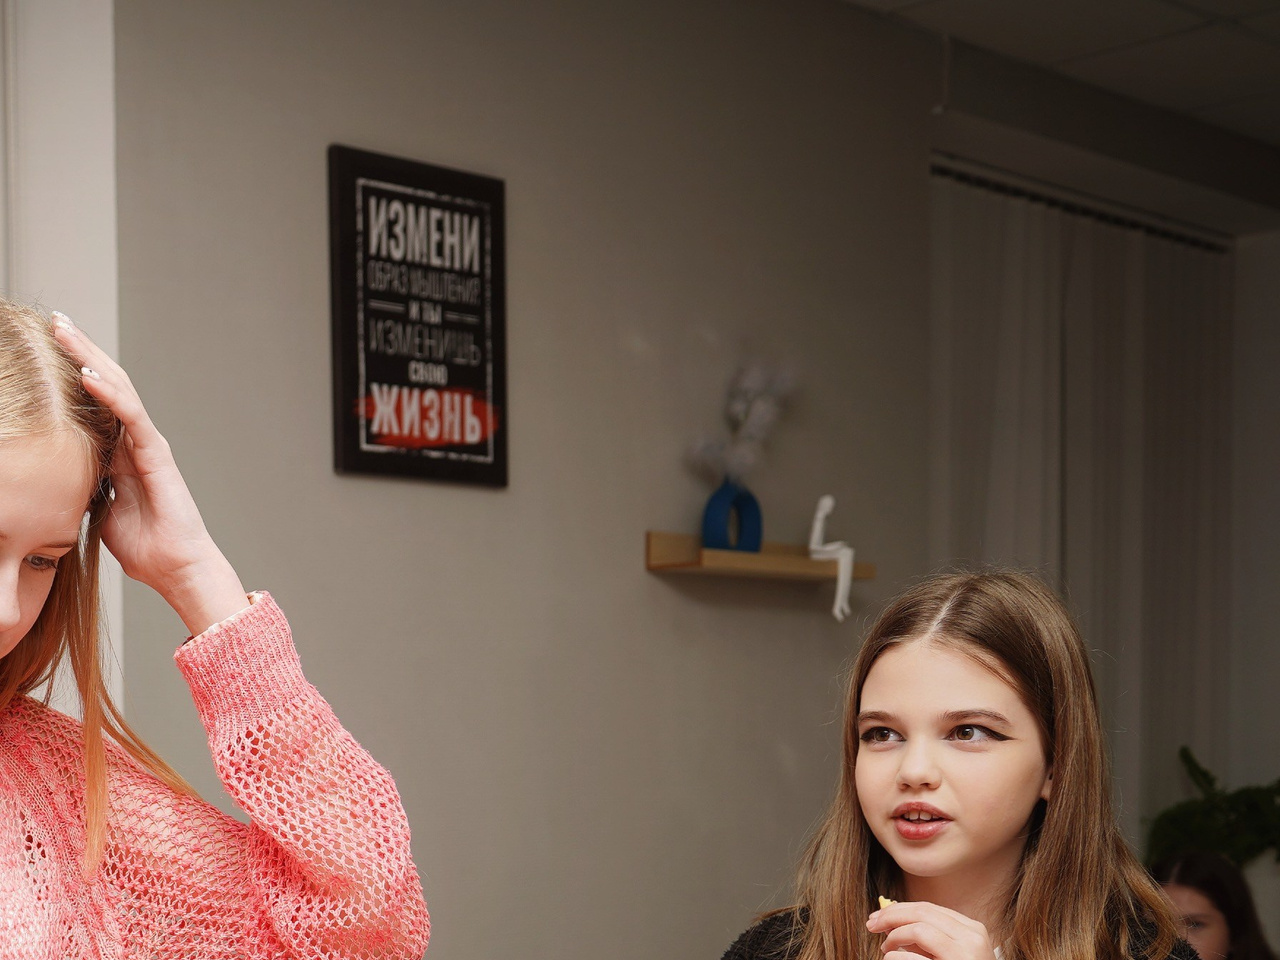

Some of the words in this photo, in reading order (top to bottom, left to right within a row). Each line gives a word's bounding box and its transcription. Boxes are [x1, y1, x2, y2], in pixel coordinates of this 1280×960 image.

[369, 195, 480, 274] ИЗМЕНИ
[367, 259, 408, 295] ОБРАЗ
[408, 299, 420, 321] И
[422, 301, 442, 325] ТЫ
[369, 317, 481, 367] ИЗМЕНИШЬ
[408, 359, 448, 386] СВОЮ
[370, 382, 482, 445] ЖИЗНЬ
